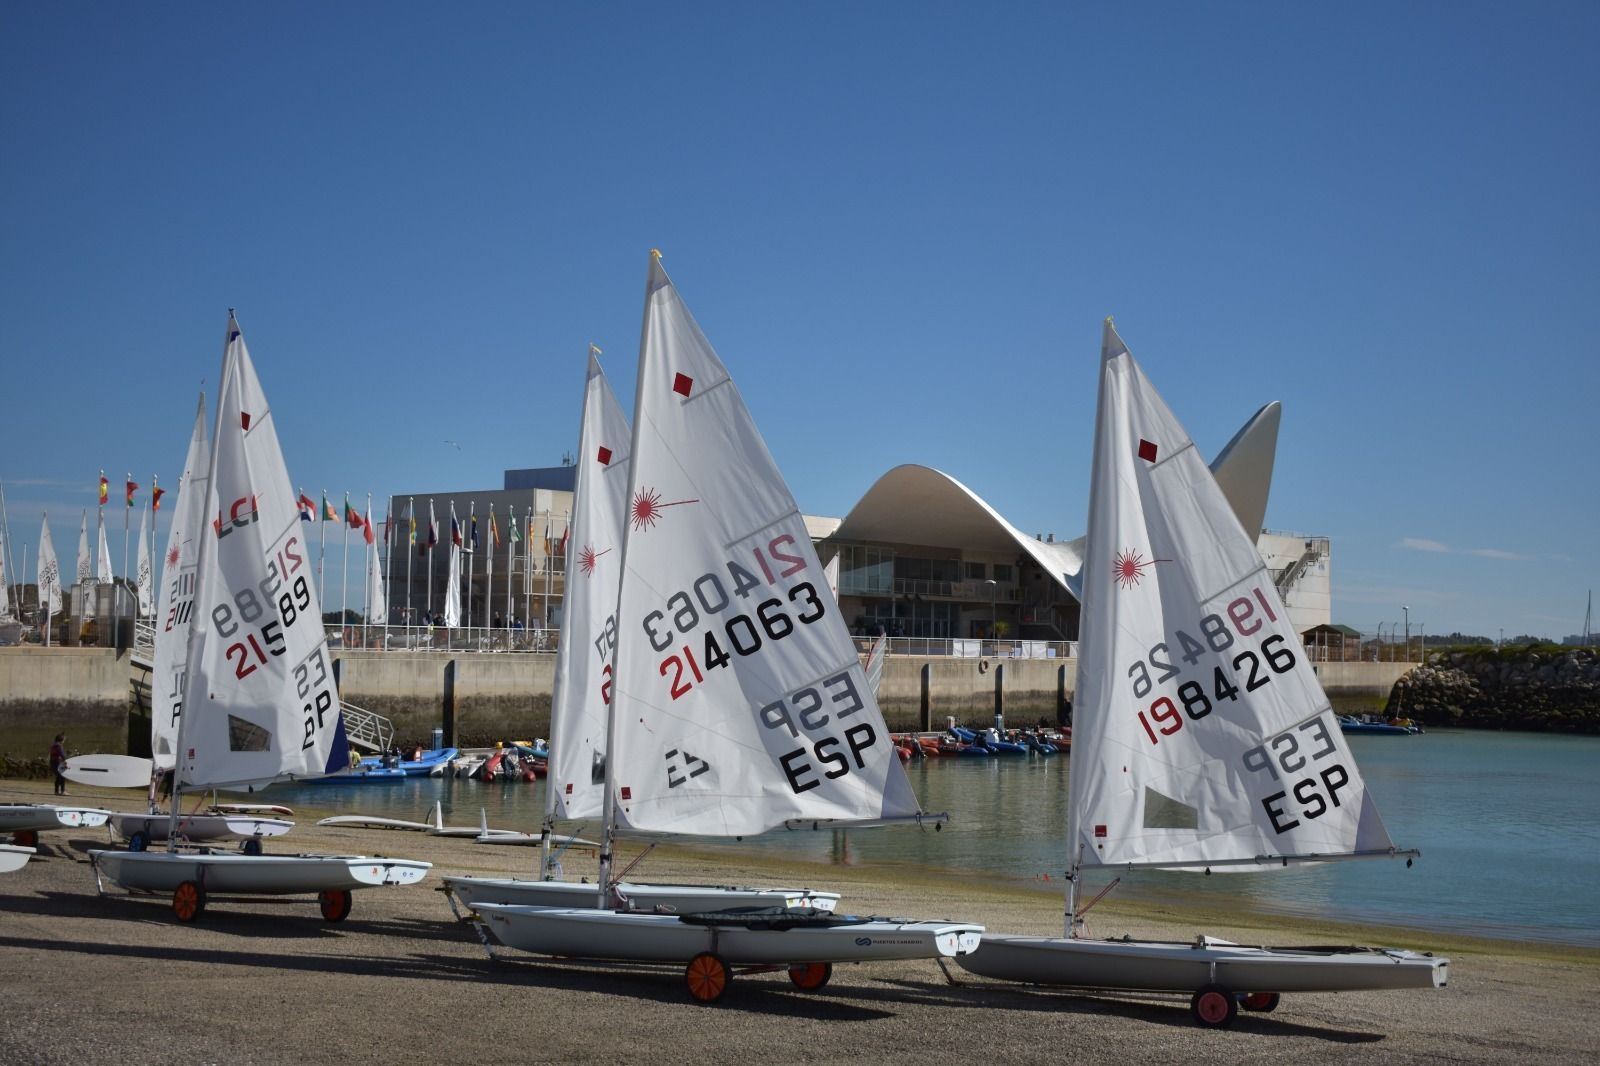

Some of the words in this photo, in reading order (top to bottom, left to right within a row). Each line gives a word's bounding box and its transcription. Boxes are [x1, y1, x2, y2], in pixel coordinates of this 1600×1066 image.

[659, 581, 825, 701] 214063
[1137, 634, 1296, 745] 198426
[778, 722, 877, 795] ESP
[1260, 764, 1349, 835] ESP
